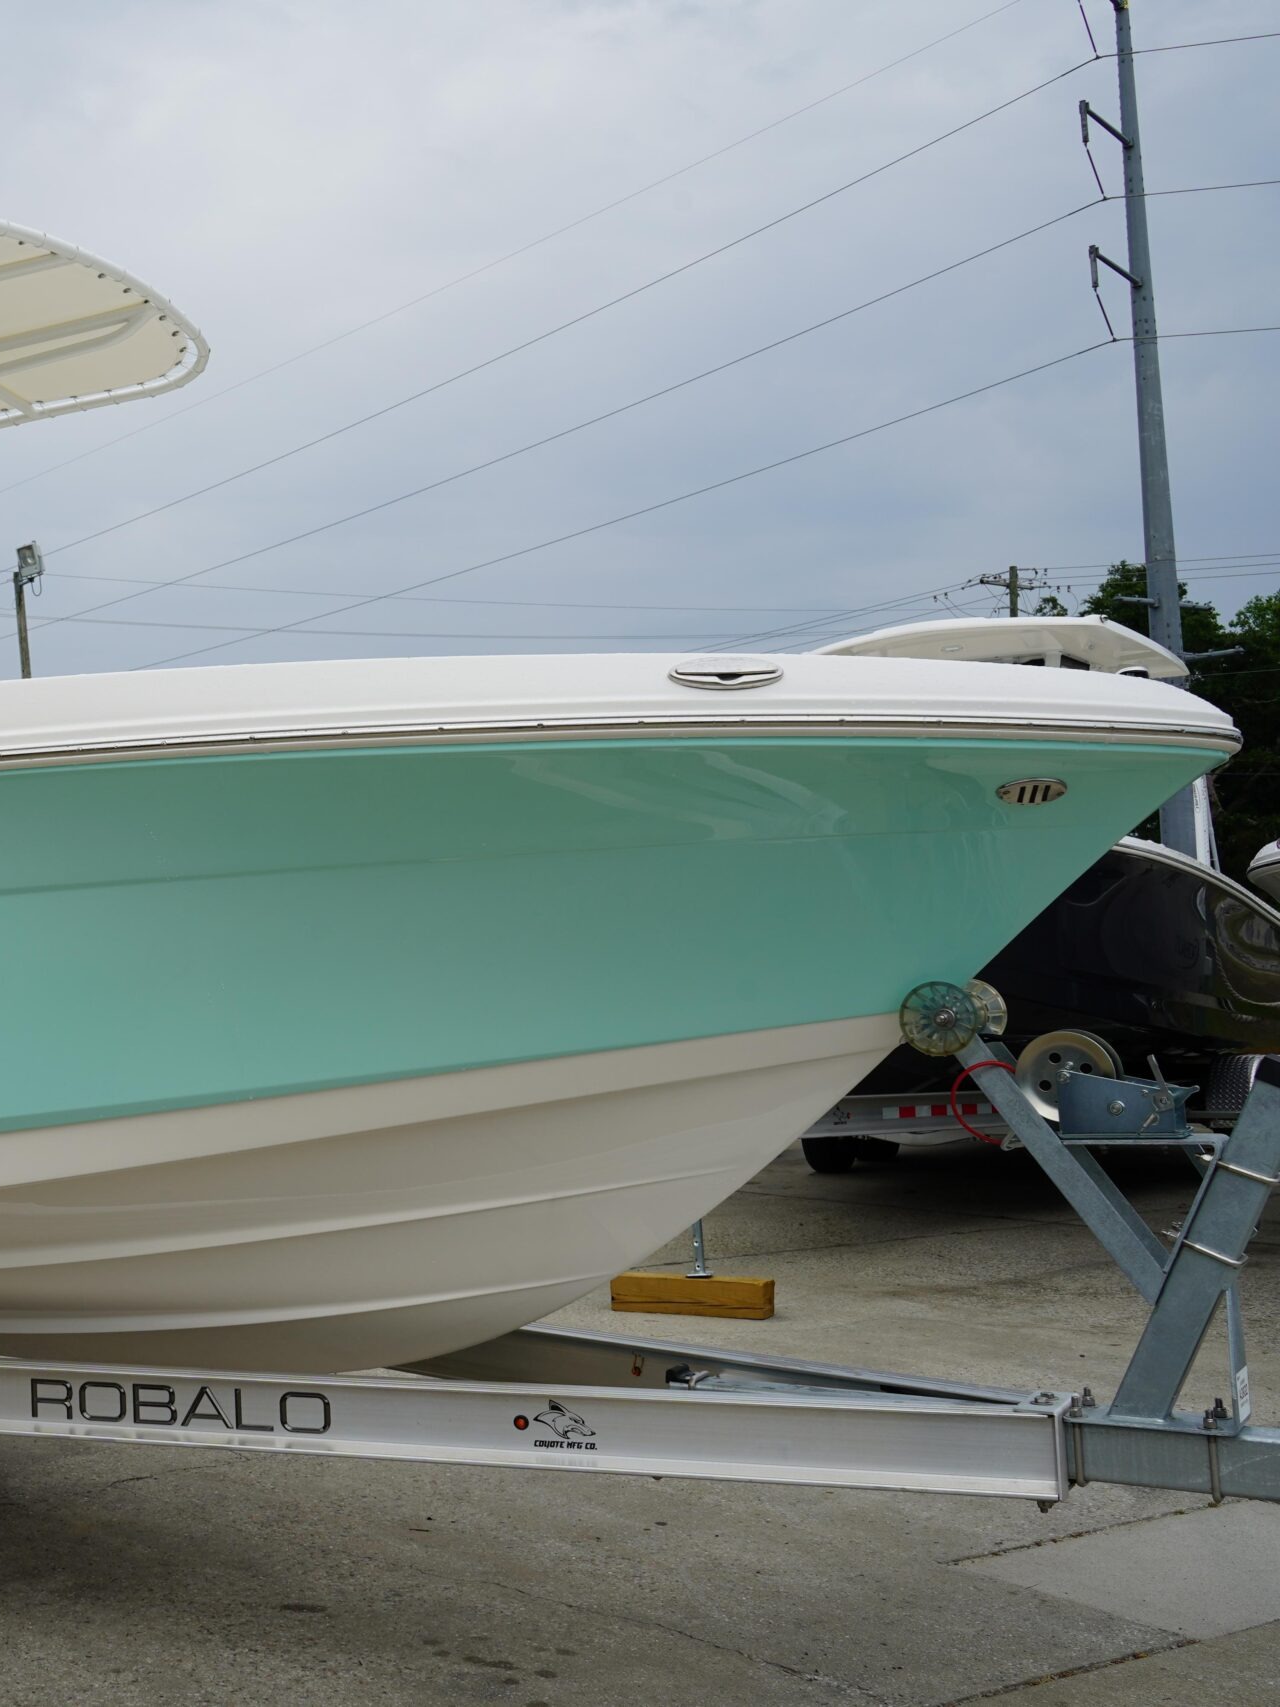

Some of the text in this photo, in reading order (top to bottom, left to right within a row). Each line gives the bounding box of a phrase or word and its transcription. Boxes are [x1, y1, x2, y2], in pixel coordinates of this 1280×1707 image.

[30, 1378, 332, 1434] ROBALO
[533, 1439, 598, 1451] COYOTE MFG CO.
